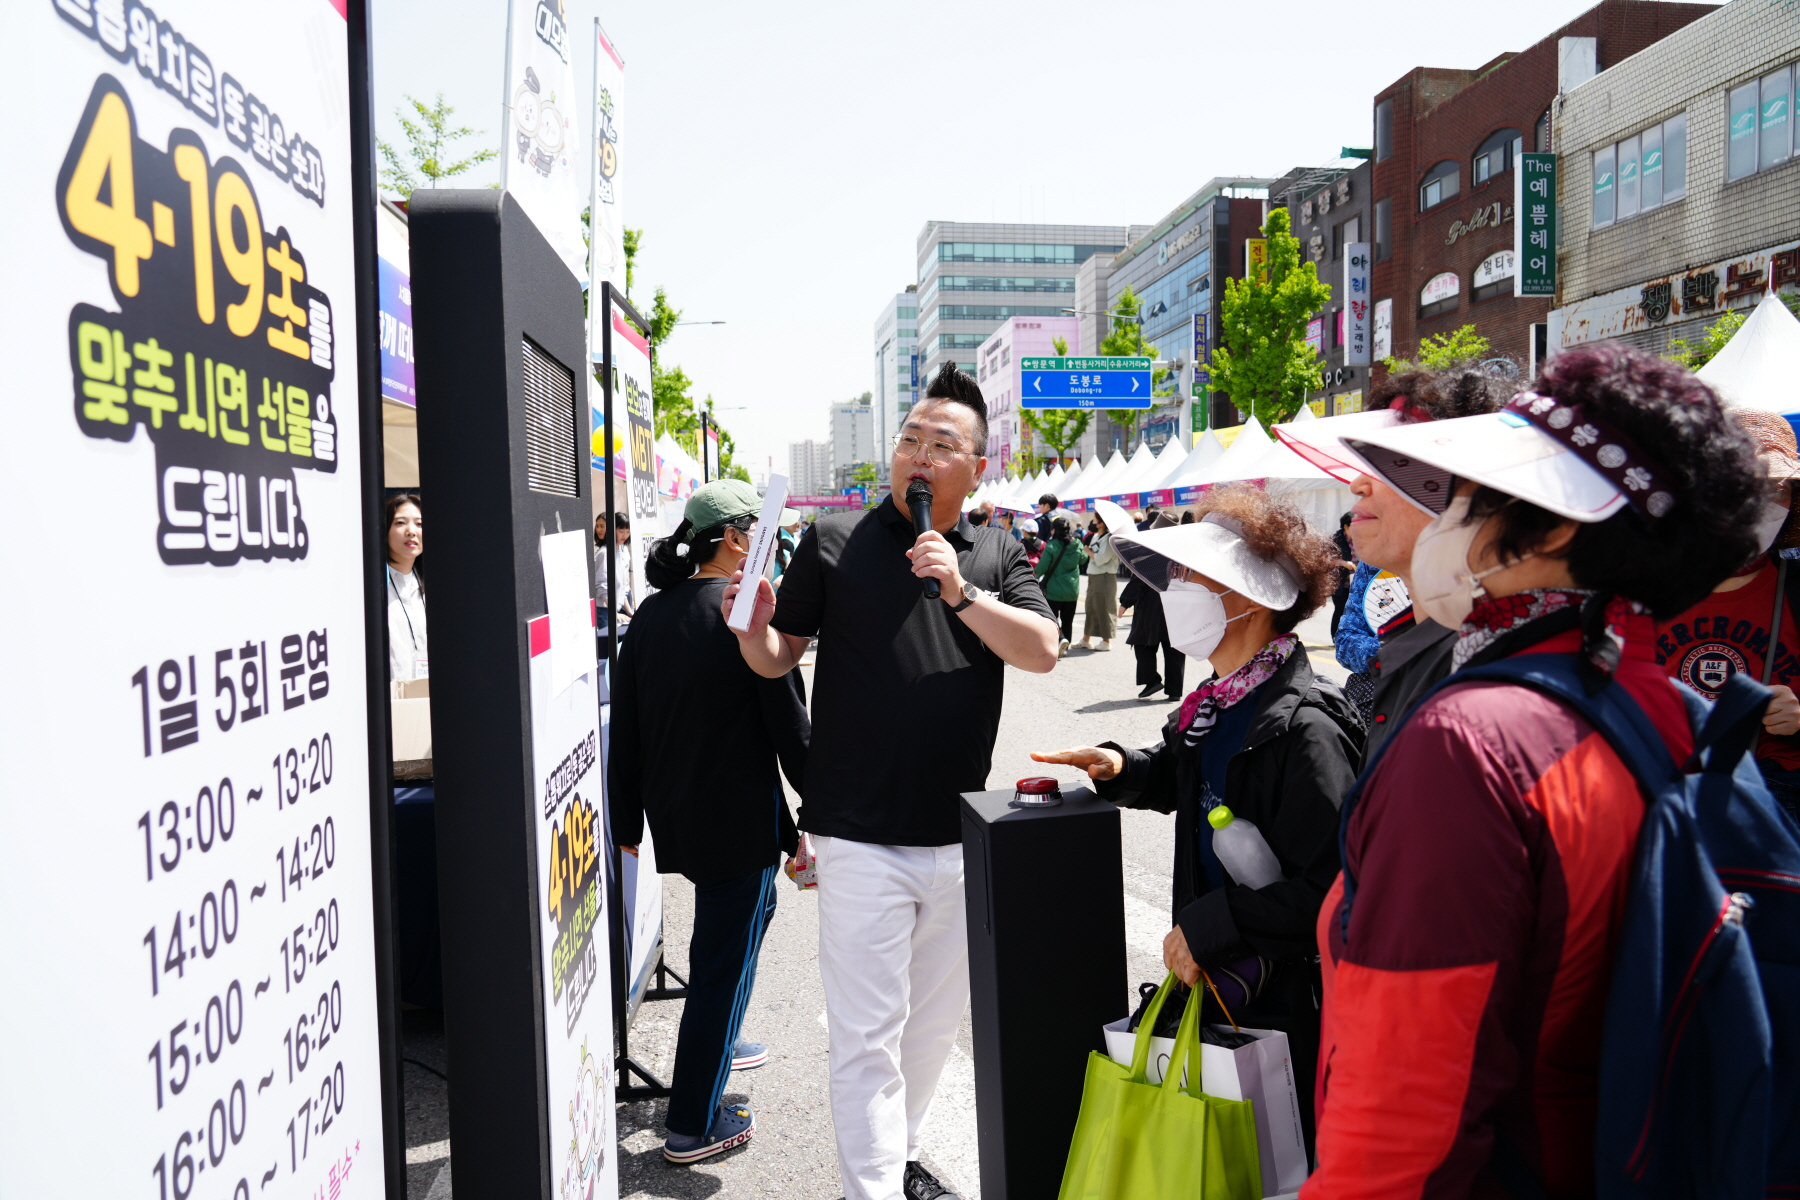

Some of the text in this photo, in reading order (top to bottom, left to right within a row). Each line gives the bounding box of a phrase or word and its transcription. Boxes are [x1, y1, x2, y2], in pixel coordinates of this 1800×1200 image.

[1526, 160, 1552, 172] The
[1351, 254, 1368, 353] 아리랑 노래방
[78, 321, 336, 461] 맞추시면 선물을
[1069, 375, 1103, 387] 도봉로
[1109, 360, 1142, 368] 수유사거리
[164, 466, 305, 551] 드립니다.
[131, 628, 330, 758] 1일 5회 운영
[1705, 662, 1722, 670] A&F
[1708, 646, 1746, 674] DEPARTMEN
[138, 777, 235, 882] 13:00
[273, 732, 334, 810] 13:20
[143, 879, 239, 997] 14:00
[276, 816, 336, 903] 14:20
[553, 870, 602, 997] 맞추시면 선물을
[148, 979, 243, 1112] 15:00
[280, 898, 339, 993] 15:20
[567, 938, 596, 1031] 드립니다.
[152, 1079, 246, 1200] 16:00
[283, 980, 342, 1084] 16:20
[286, 1061, 345, 1174] 17:20
